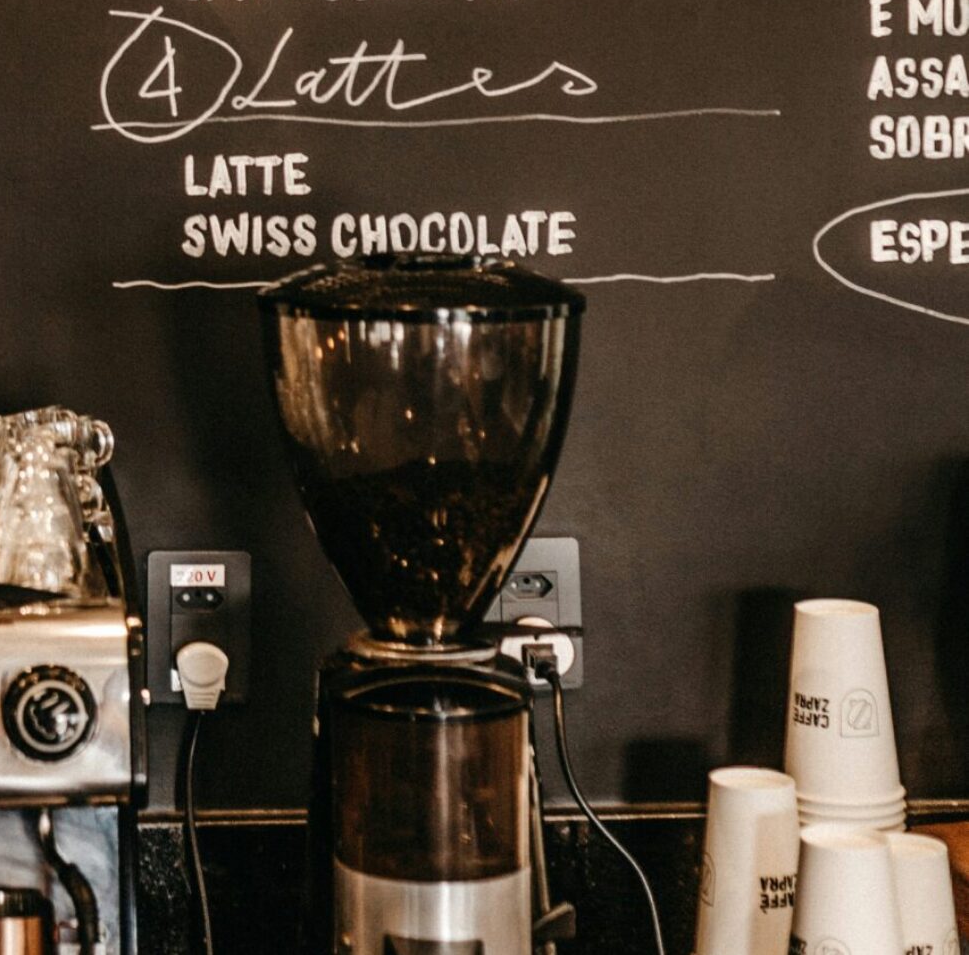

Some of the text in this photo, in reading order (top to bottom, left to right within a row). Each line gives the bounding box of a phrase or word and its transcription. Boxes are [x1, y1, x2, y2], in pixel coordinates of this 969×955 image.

[138, 27, 598, 117] 4 Lattes
[184, 152, 312, 198] LATTE
[181, 210, 577, 258] SWISS CHOCOLATE
[759, 873, 798, 892] APRA
